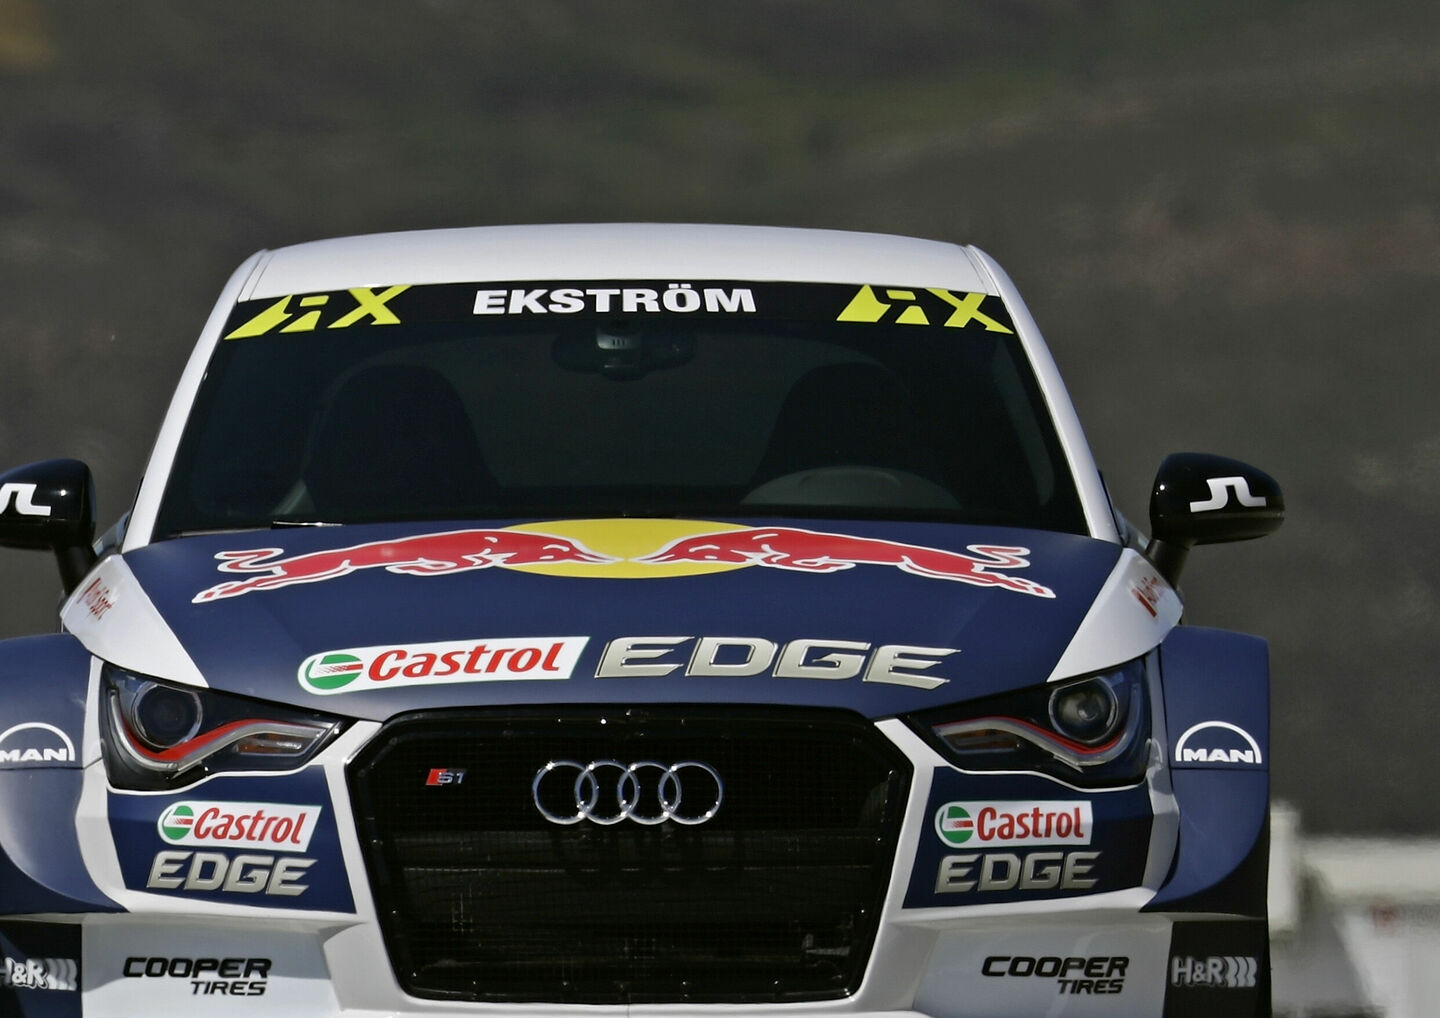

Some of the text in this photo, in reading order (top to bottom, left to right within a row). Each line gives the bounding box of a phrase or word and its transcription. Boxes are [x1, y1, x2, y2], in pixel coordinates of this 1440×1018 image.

[472, 283, 757, 315] EKSTRÖM
[367, 636, 962, 690] Castrol EDGE
[1183, 747, 1255, 764] MAN
[194, 807, 308, 844] Castrol
[977, 806, 1085, 841] Castrol
[146, 850, 318, 896] EDGE
[934, 851, 1102, 894] EDGE
[123, 957, 272, 979] COOPER
[981, 956, 1130, 978] COOPER
[1171, 956, 1226, 987] H&R
[189, 980, 267, 996] TIRES
[1057, 979, 1126, 995] TIRES
